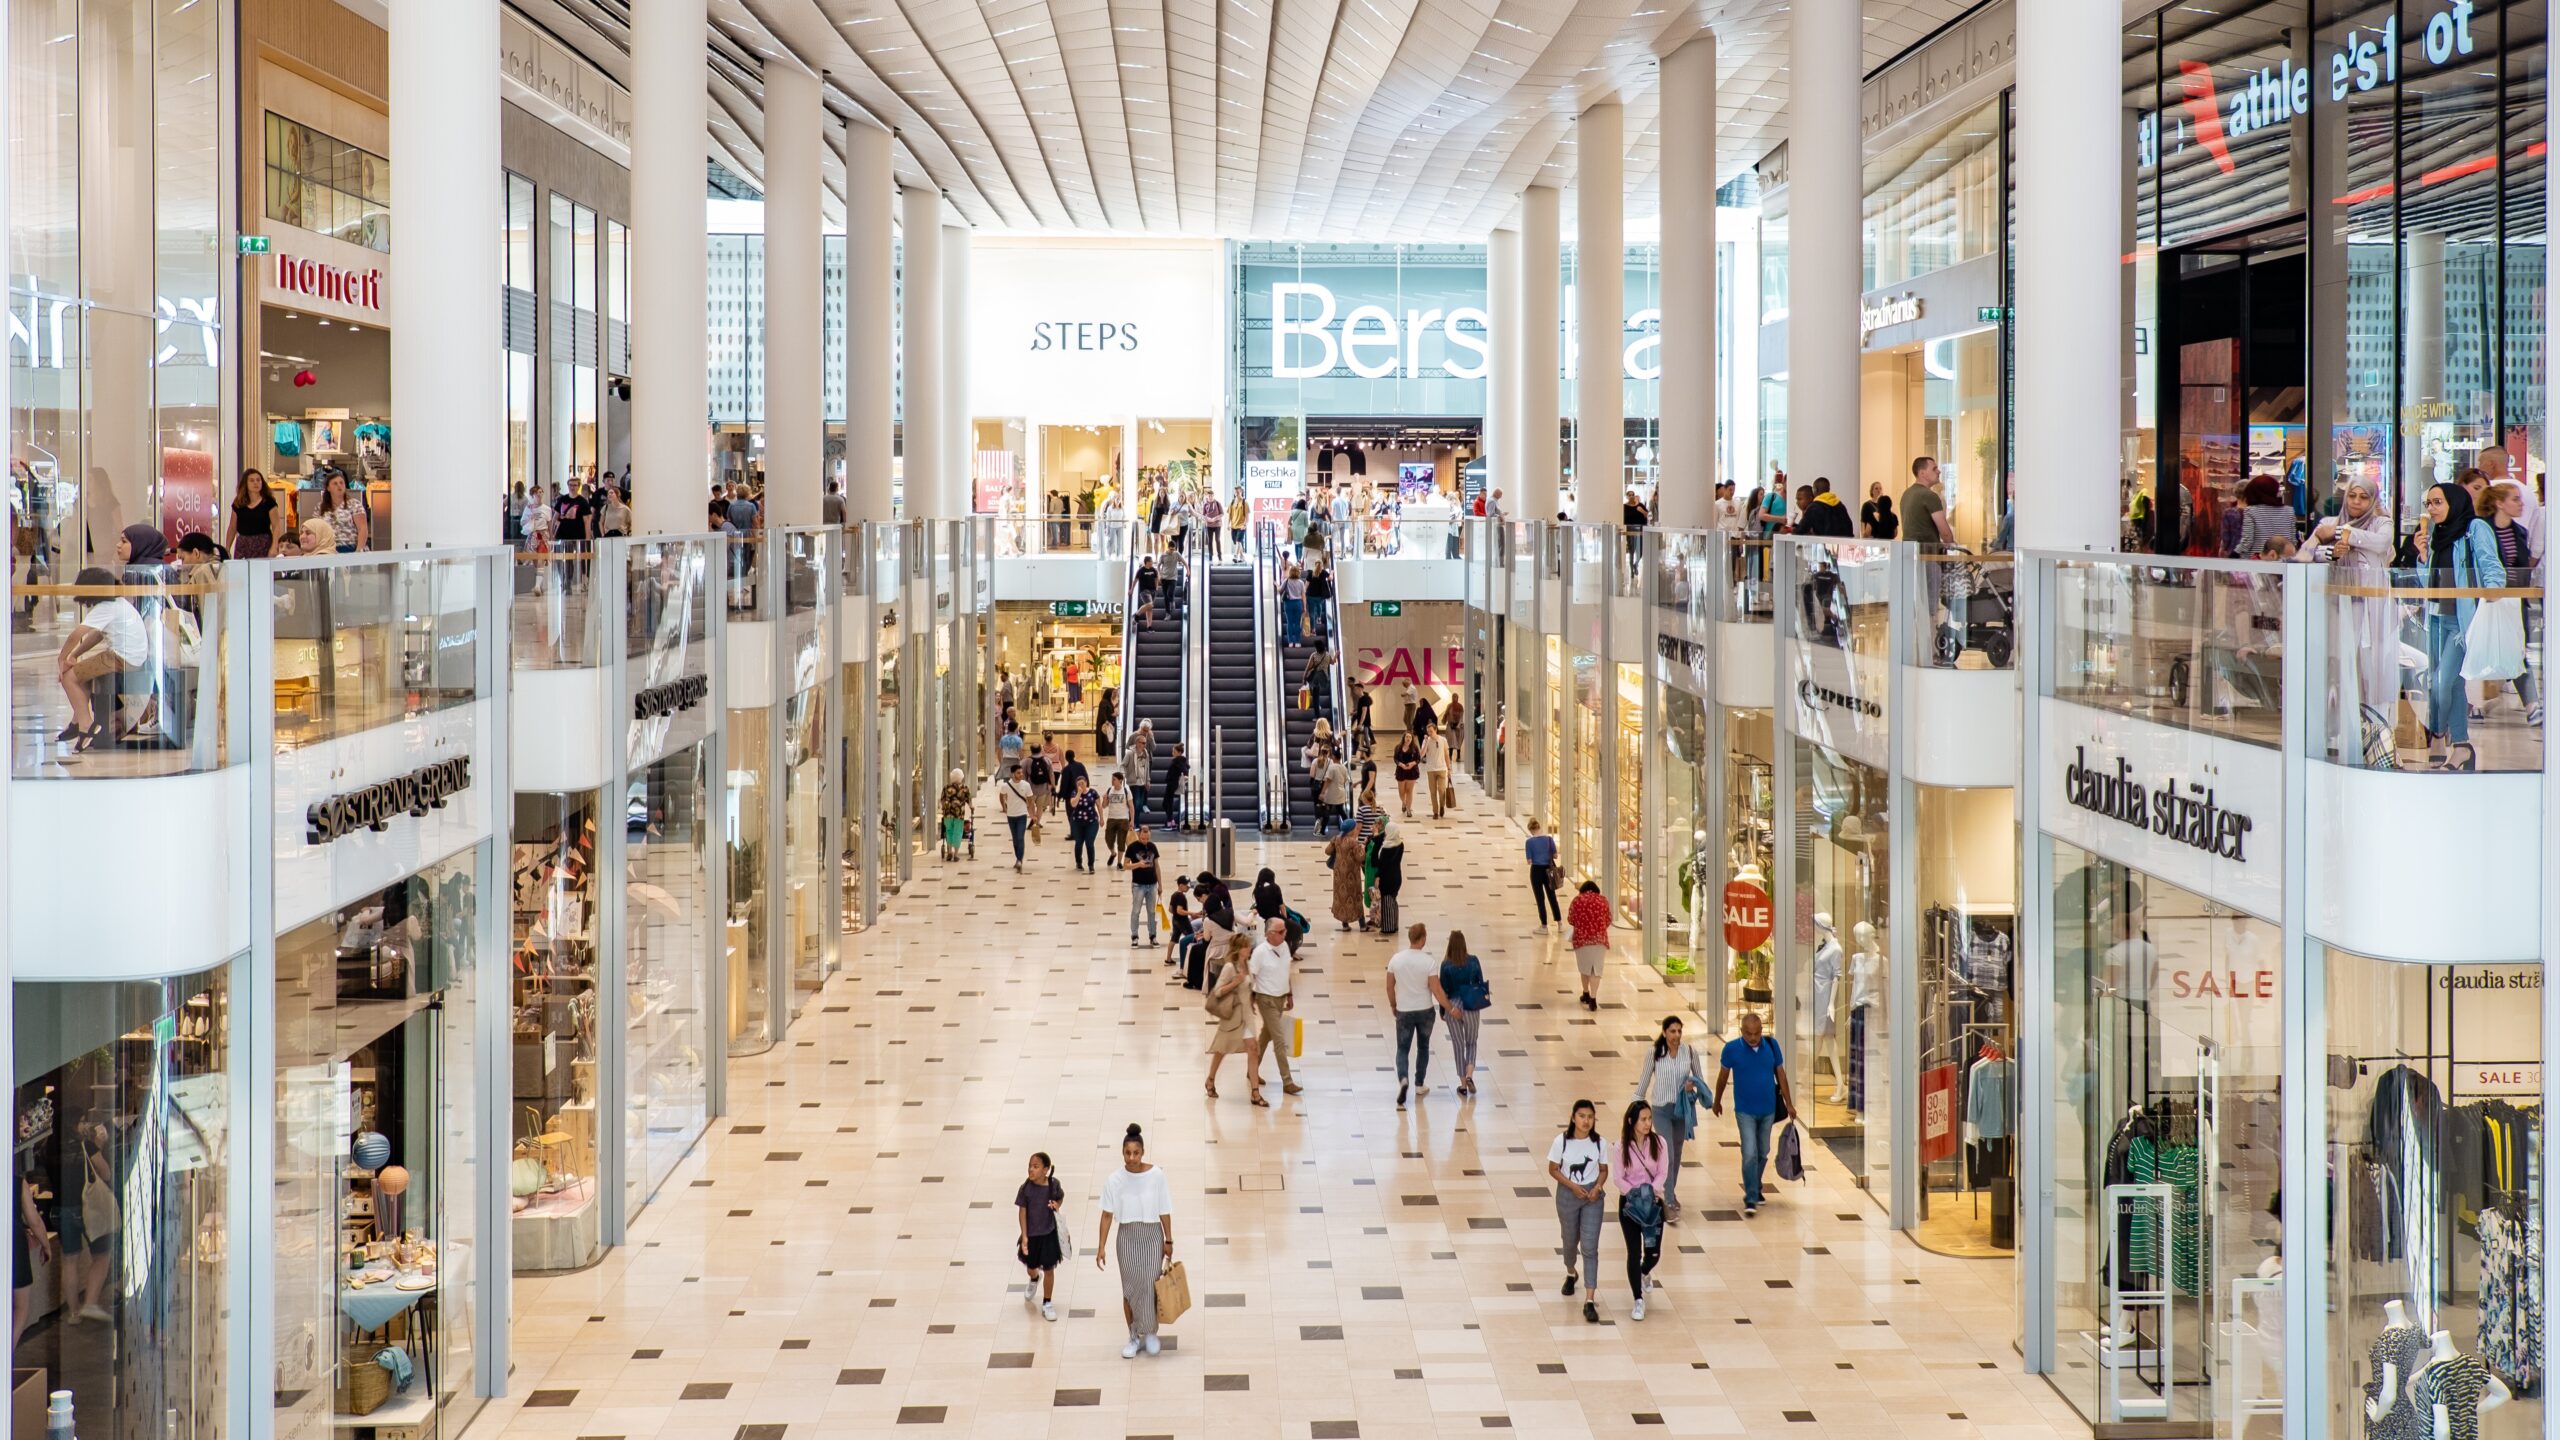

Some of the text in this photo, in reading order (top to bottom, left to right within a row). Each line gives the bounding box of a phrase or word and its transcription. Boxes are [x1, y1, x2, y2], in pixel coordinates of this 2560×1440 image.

[2229, 0, 2474, 138] athlee's fot
[1031, 322, 1138, 351] STEPS
[1272, 282, 1660, 380] Bersa
[2429, 401, 2455, 418] WITH
[1250, 465, 1297, 478] Bershka
[176, 486, 202, 513] Sale
[1262, 499, 1285, 511] SALE
[1358, 647, 1464, 686] SALE
[307, 754, 471, 845] SØSTRENE GRENE
[2065, 745, 2252, 863] claudia sträter
[1723, 903, 1769, 928] SALE
[2172, 970, 2273, 999] SALE
[2439, 969, 2506, 990] caudia
[2479, 1071, 2522, 1084] SALE
[1927, 1094, 1939, 1111] 30
[1927, 1107, 1948, 1127] 50%
